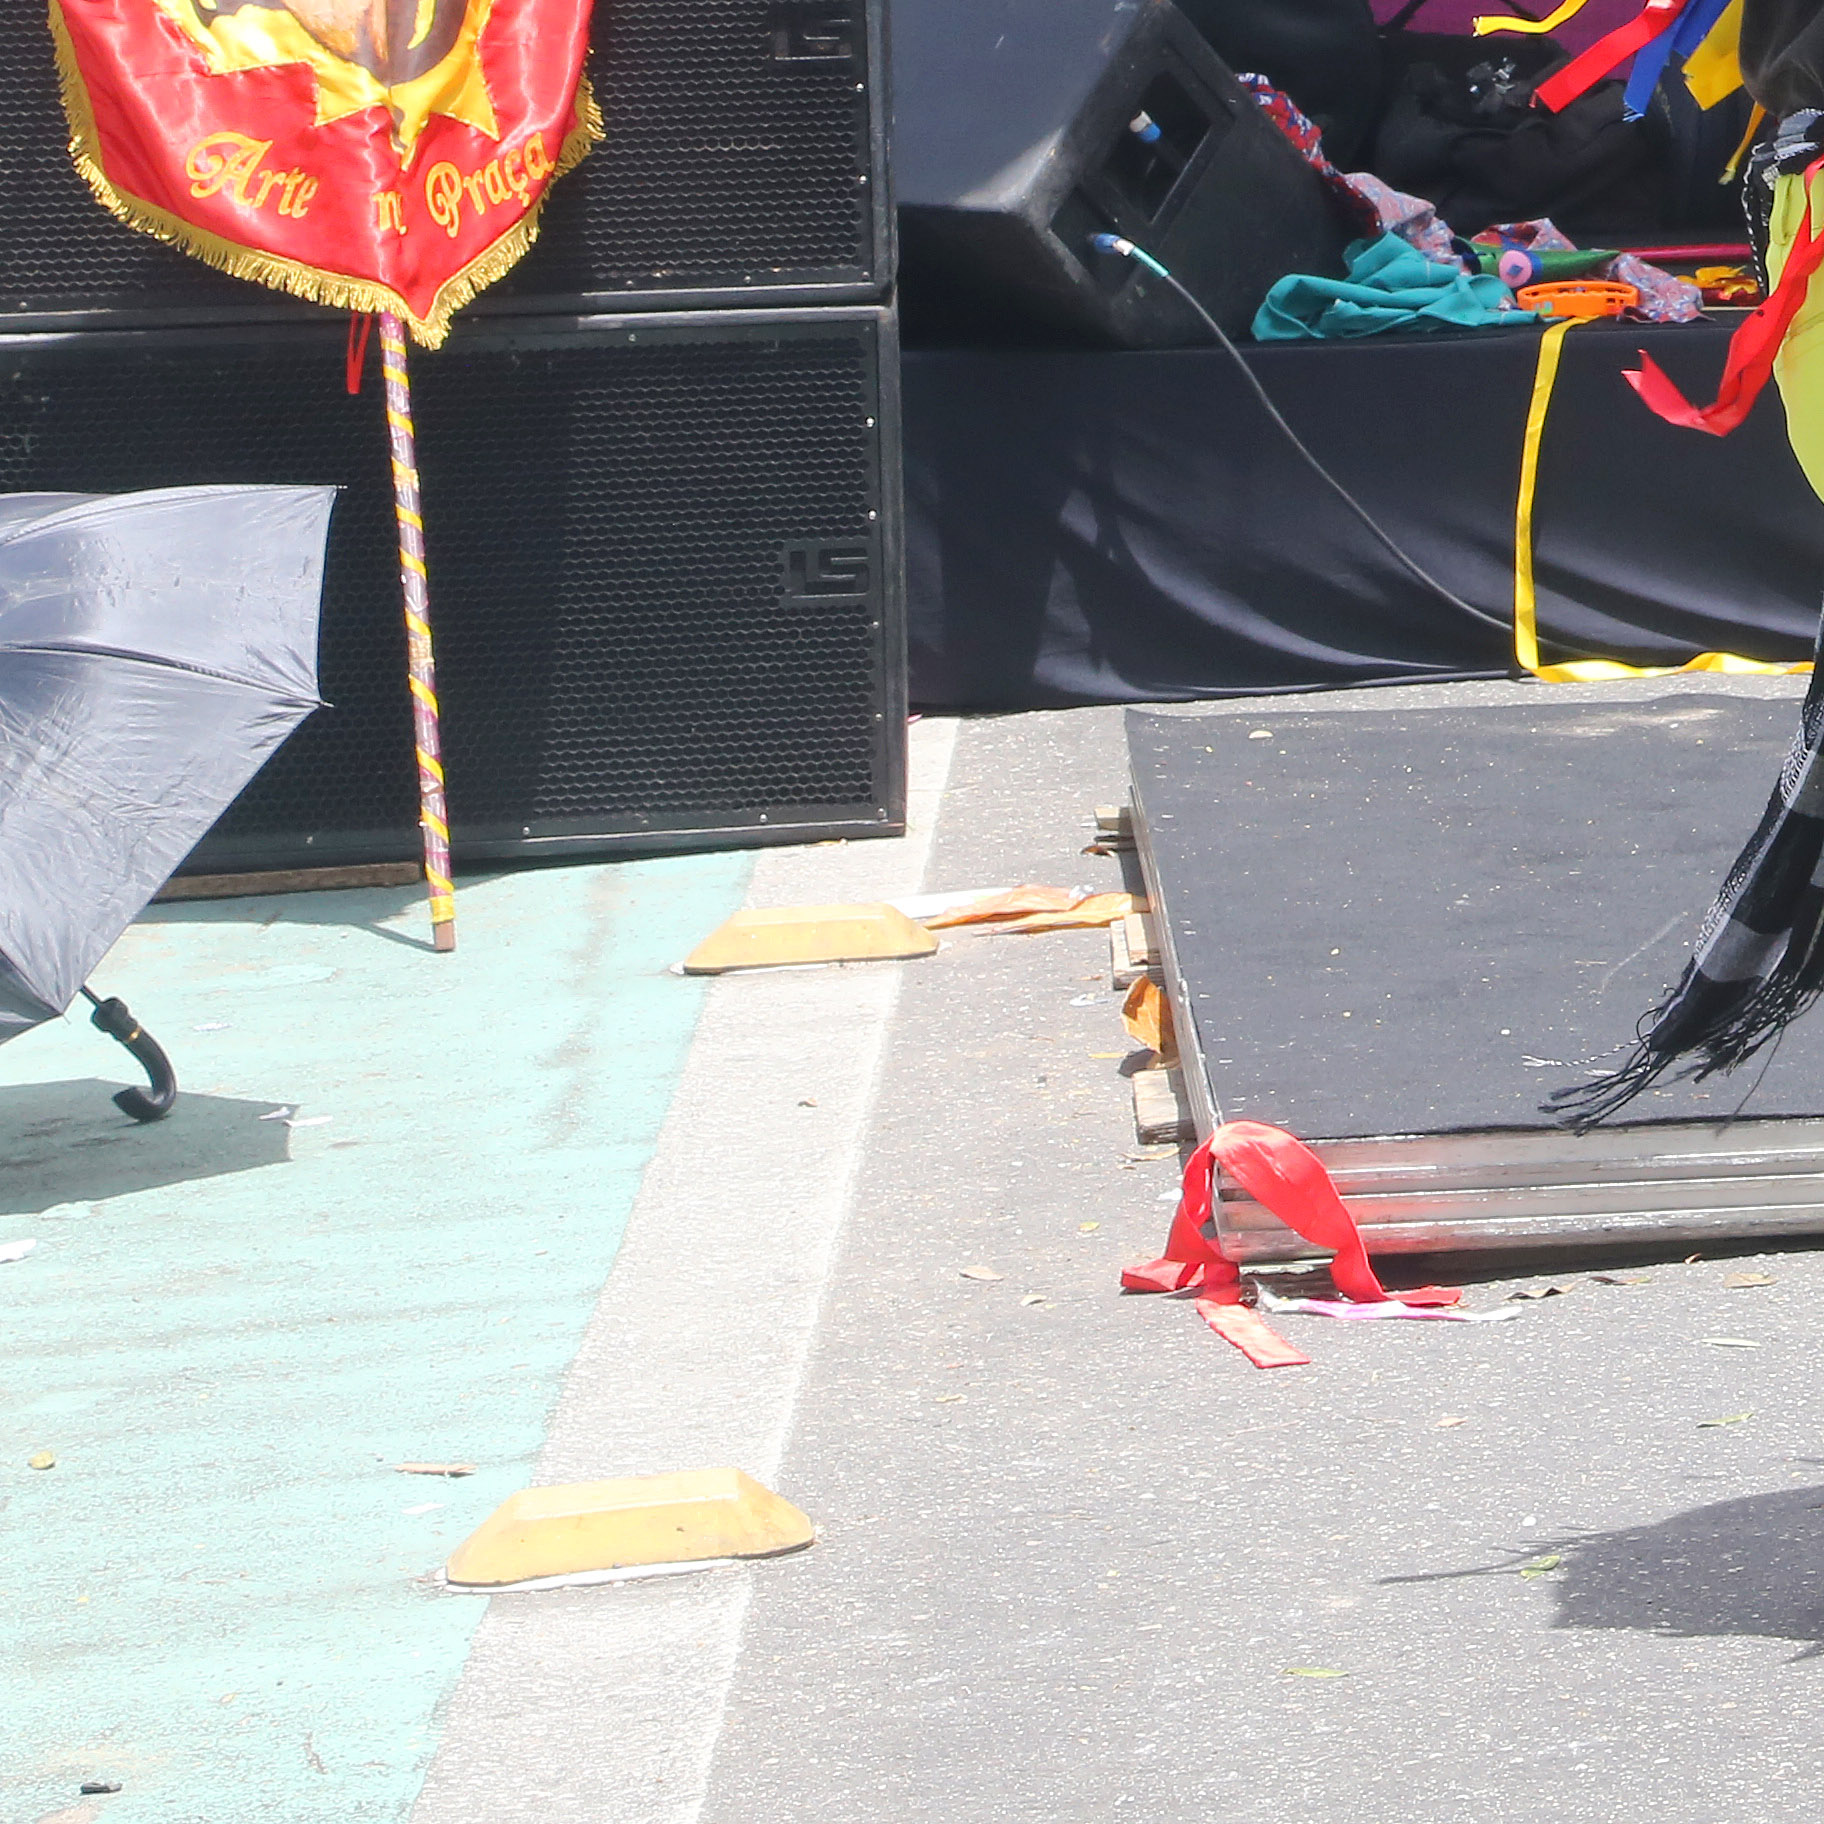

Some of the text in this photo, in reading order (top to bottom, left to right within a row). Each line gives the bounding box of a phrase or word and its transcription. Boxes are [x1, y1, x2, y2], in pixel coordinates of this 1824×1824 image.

[185, 130, 556, 239] Arte n Praça
